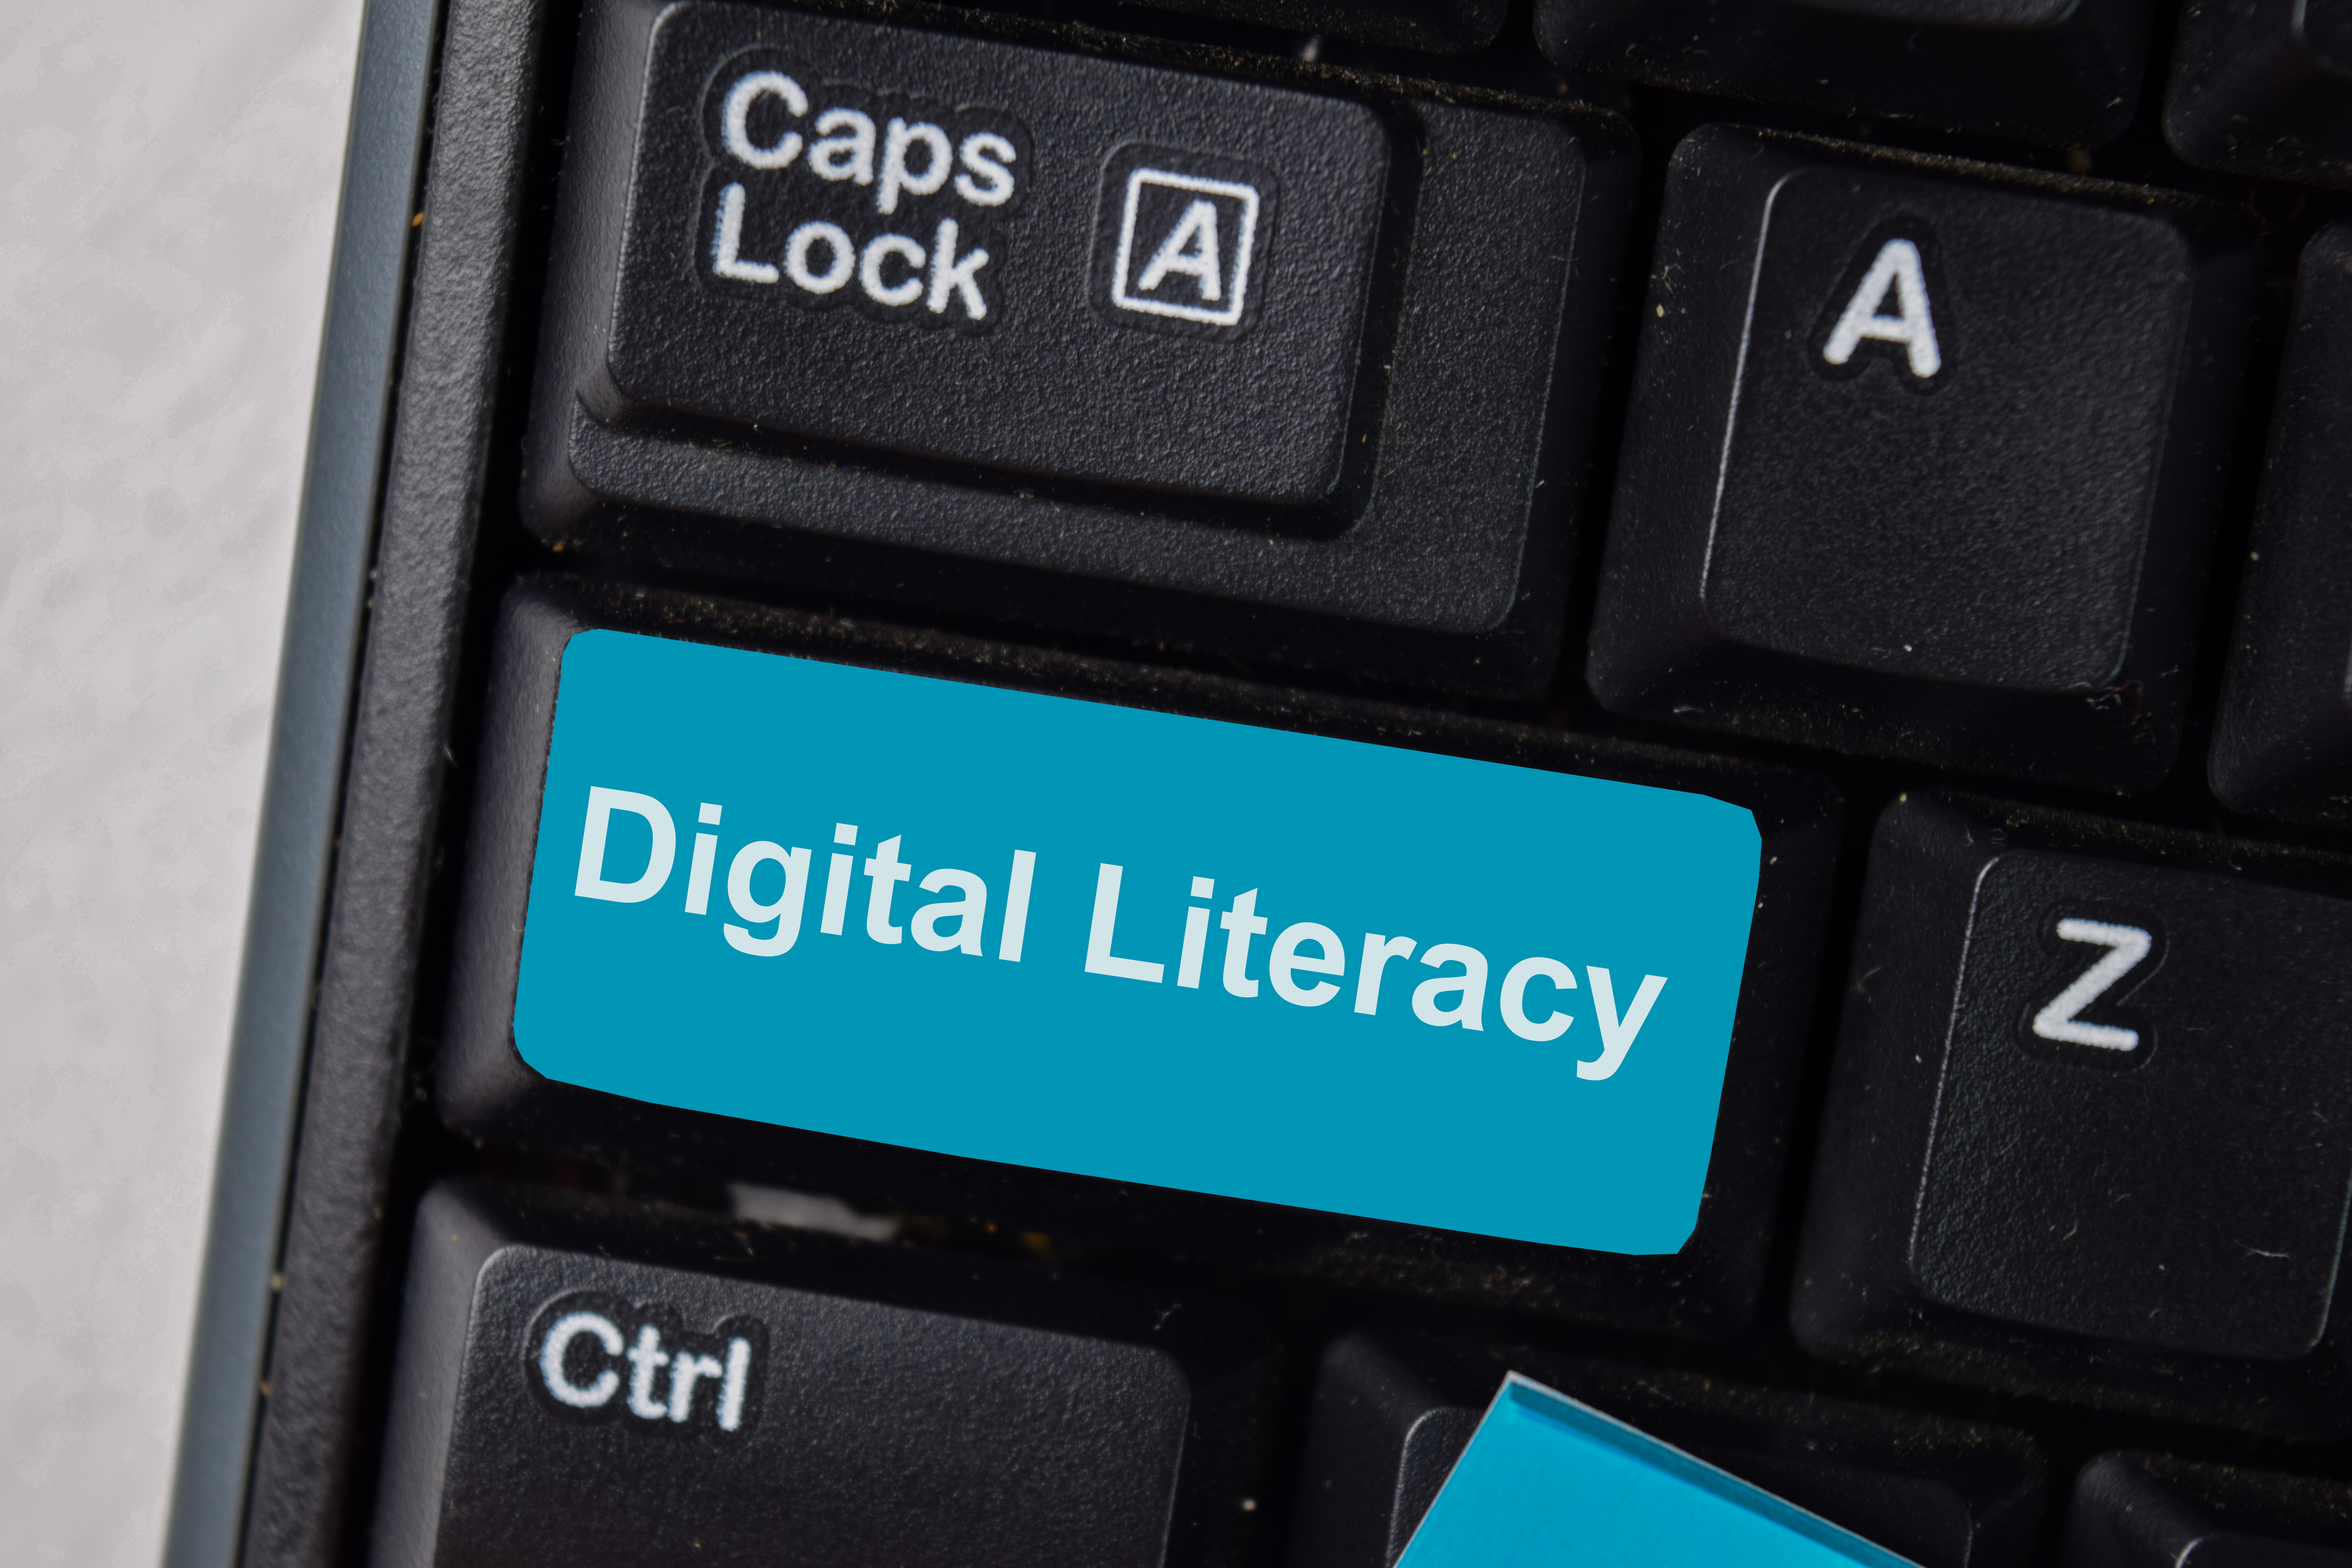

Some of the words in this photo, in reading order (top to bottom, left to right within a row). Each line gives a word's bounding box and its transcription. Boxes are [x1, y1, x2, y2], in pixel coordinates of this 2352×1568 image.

[725, 73, 1017, 213] Caps
[715, 185, 989, 320] Lock
[1138, 201, 1221, 301] A
[1826, 242, 1938, 376] A
[574, 786, 1036, 962] Digital
[1084, 863, 1668, 1081] Literacy
[2033, 920, 2148, 1050] Z
[542, 1314, 750, 1431] Ctrl
